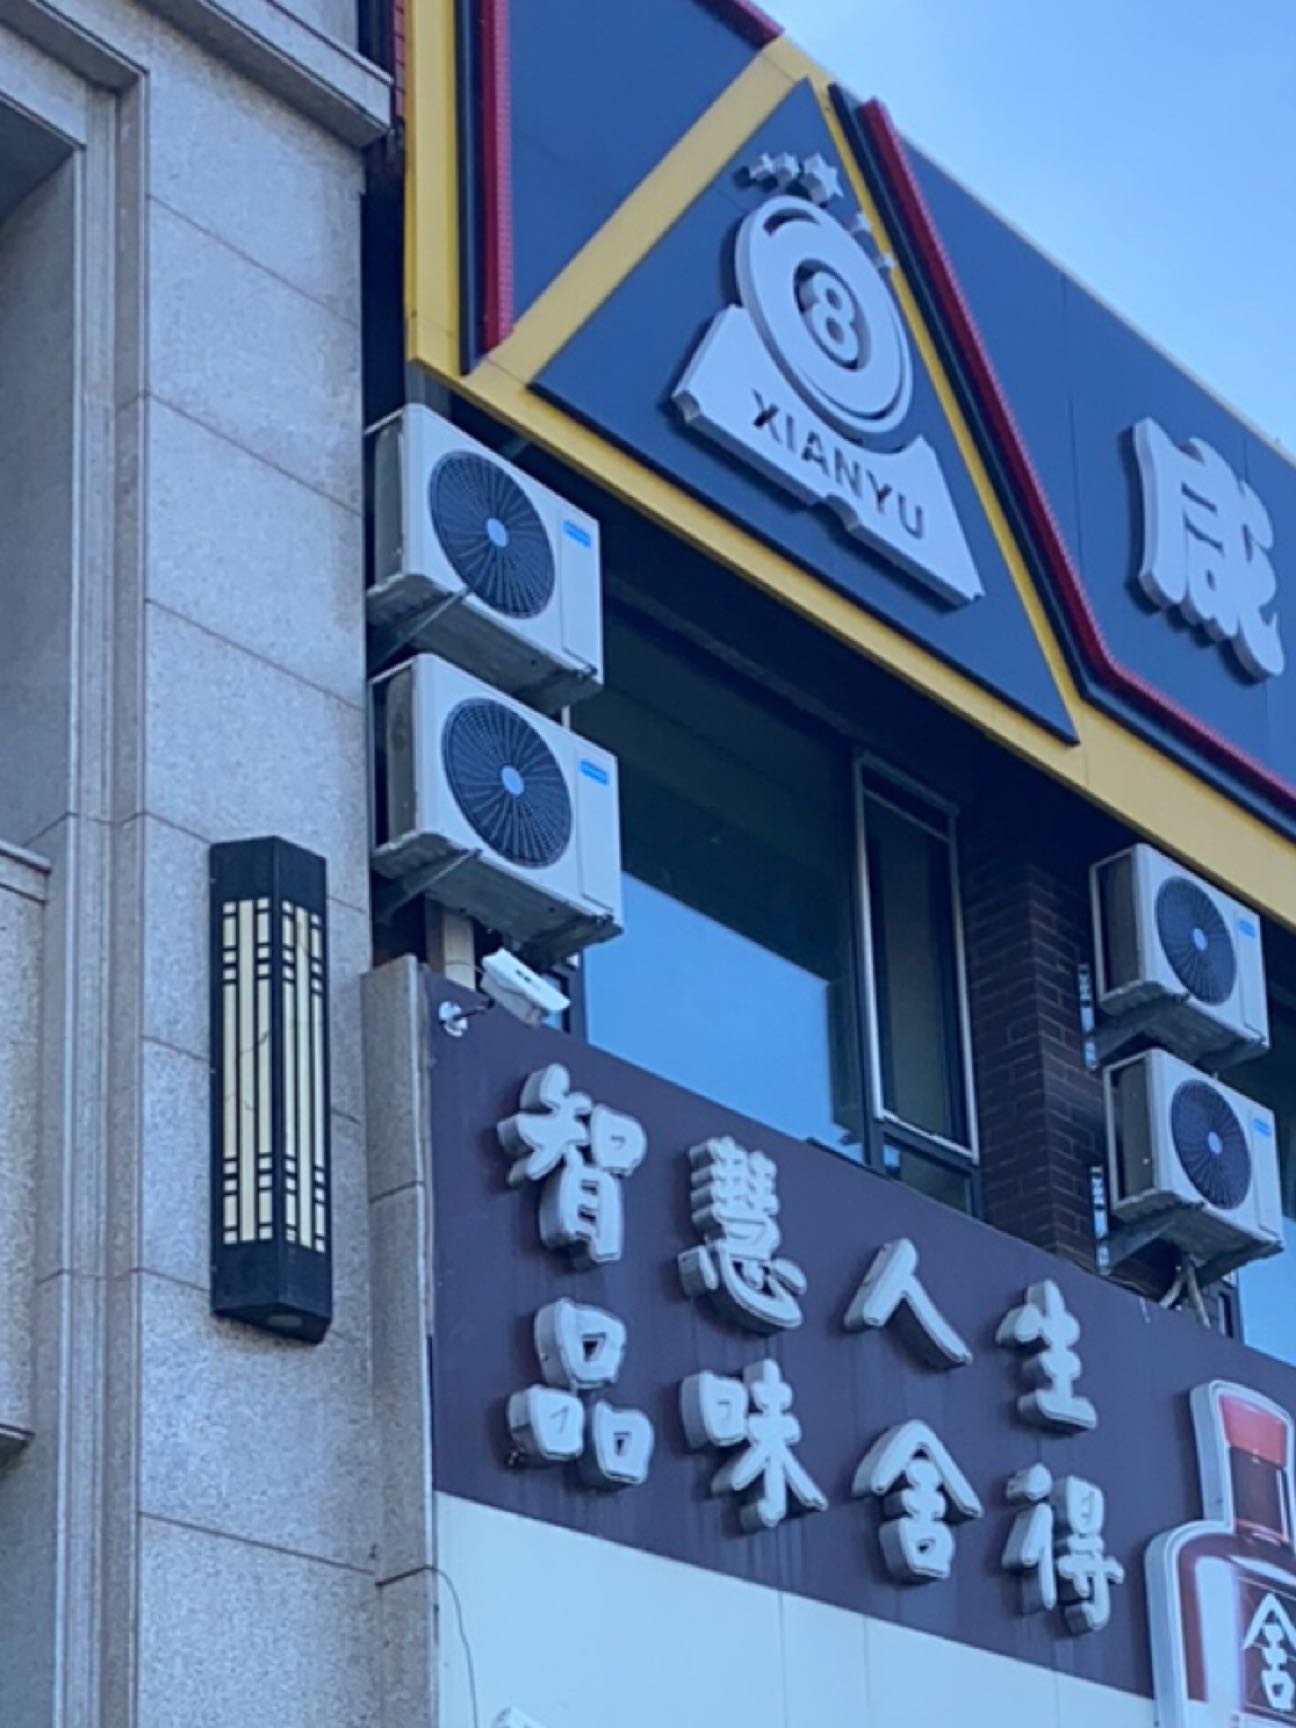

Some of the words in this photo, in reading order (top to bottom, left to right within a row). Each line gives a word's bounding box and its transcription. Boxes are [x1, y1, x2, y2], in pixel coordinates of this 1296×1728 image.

[752, 390, 925, 541] XIANYU
[498, 1063, 1098, 1431] 智慧人生
[508, 1297, 1124, 1632] 品味舍得
